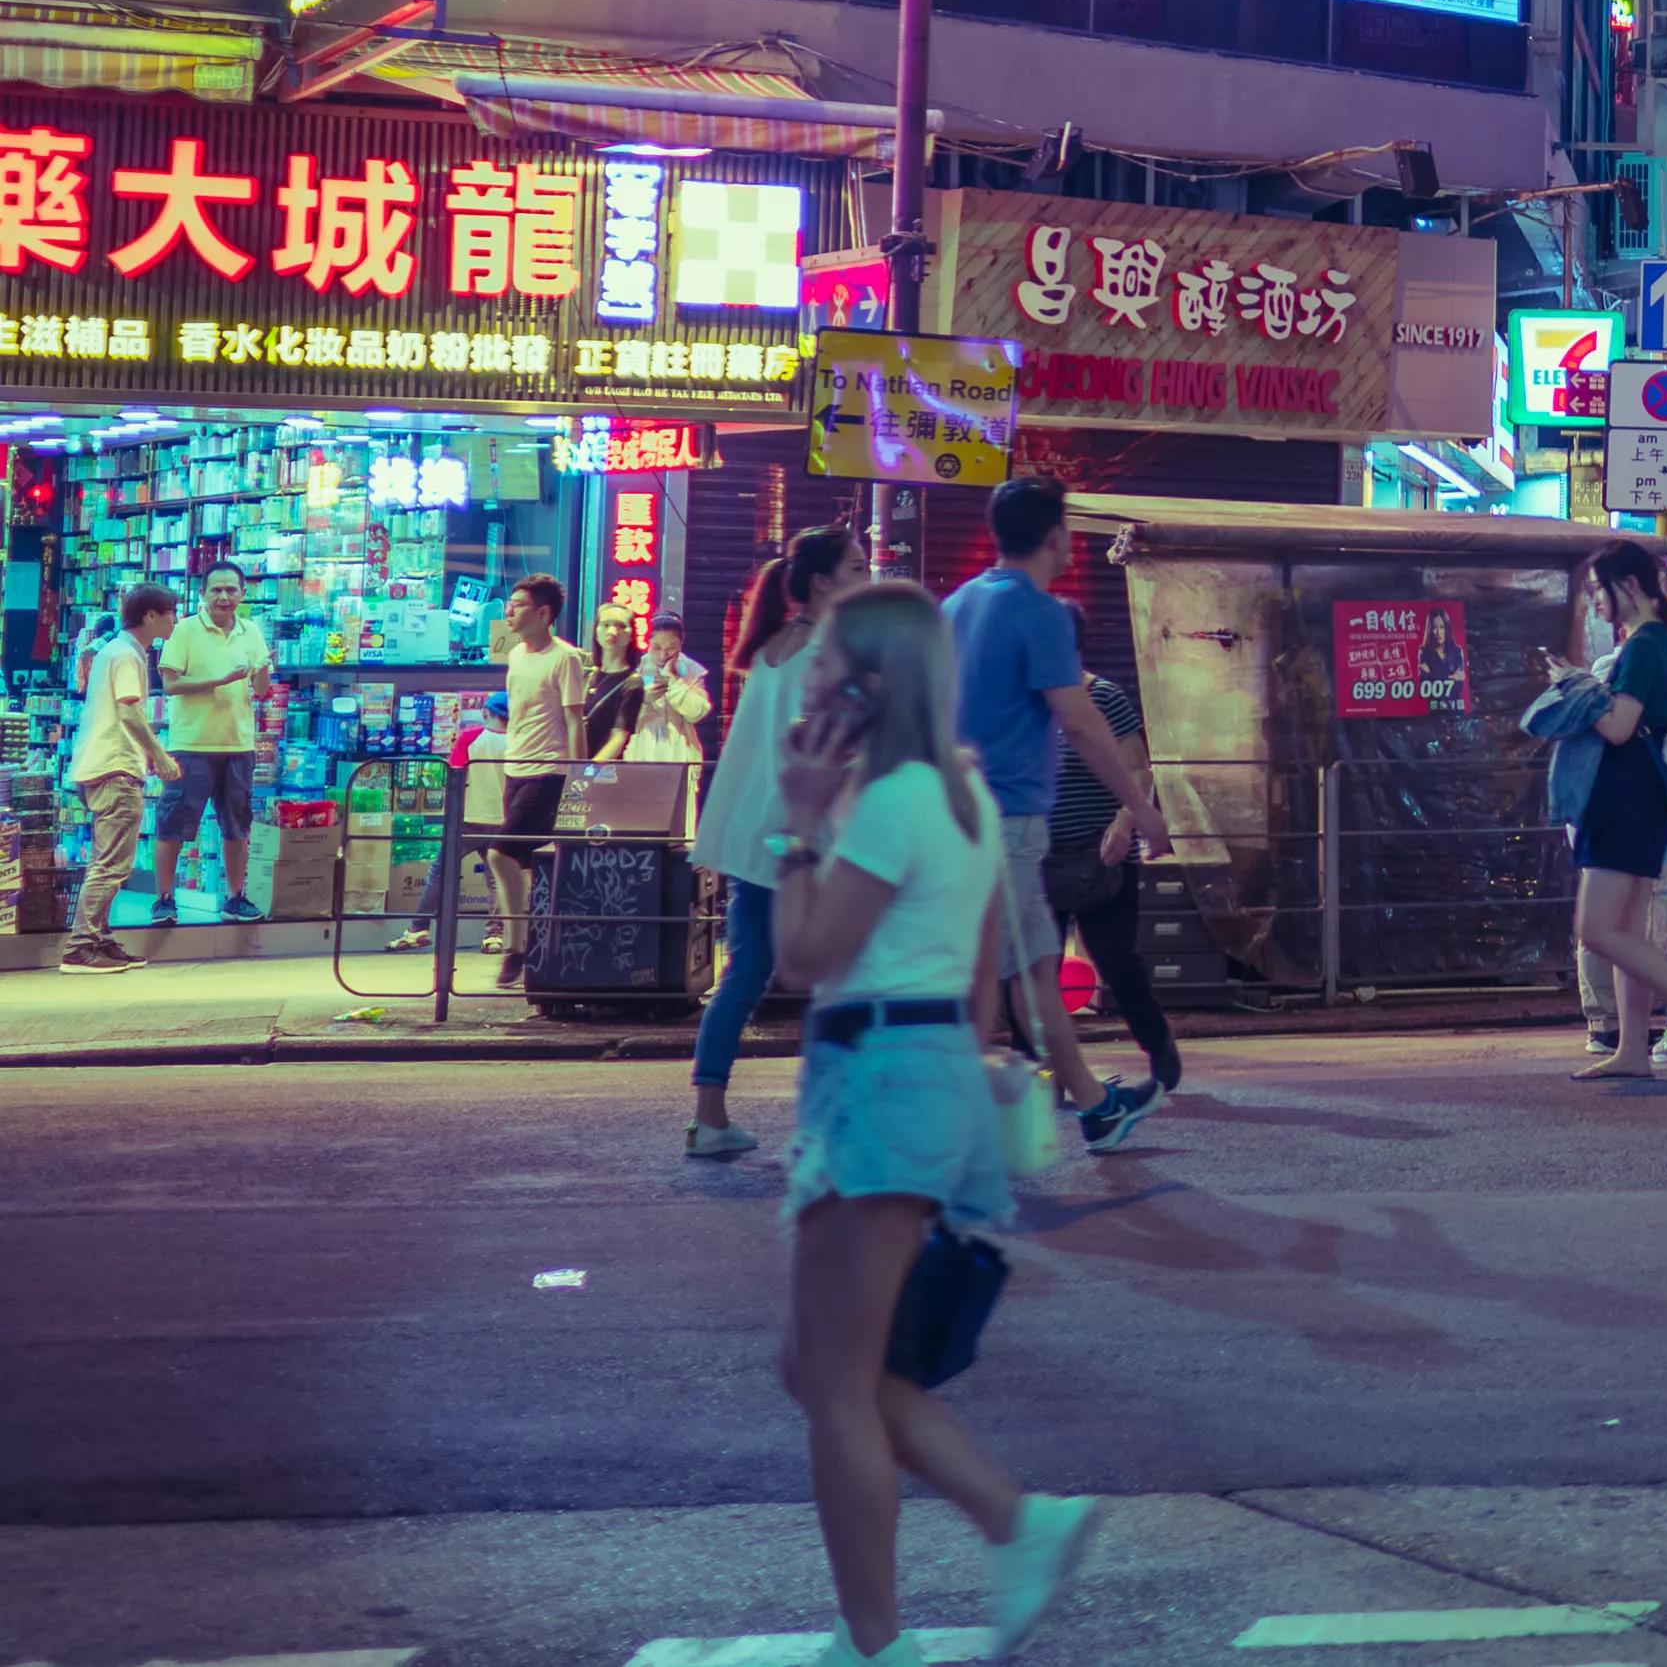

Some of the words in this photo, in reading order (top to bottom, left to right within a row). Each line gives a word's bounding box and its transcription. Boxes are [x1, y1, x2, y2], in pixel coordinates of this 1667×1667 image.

[1016, 226, 1358, 343] 昌興醇酒坊
[1396, 322, 1443, 345] SINCE
[1446, 325, 1486, 350] 1917
[820, 370, 847, 390] To
[856, 372, 940, 398] Nathan
[949, 380, 1012, 403] Road
[1018, 351, 1143, 408] CHEONG
[1151, 360, 1228, 410] HING
[1236, 363, 1342, 415] VINSAC
[869, 409, 1010, 447] 往彌敦道
[1637, 435, 1658, 445] am
[1630, 448, 1665, 463] 上午
[1636, 477, 1657, 493] pm
[1630, 490, 1663, 505] 下午
[614, 493, 657, 565] 匯款
[362, 649, 384, 658] VISA
[1352, 681, 1386, 700] 699
[1391, 680, 1415, 700] 00
[1420, 679, 1456, 699] 007
